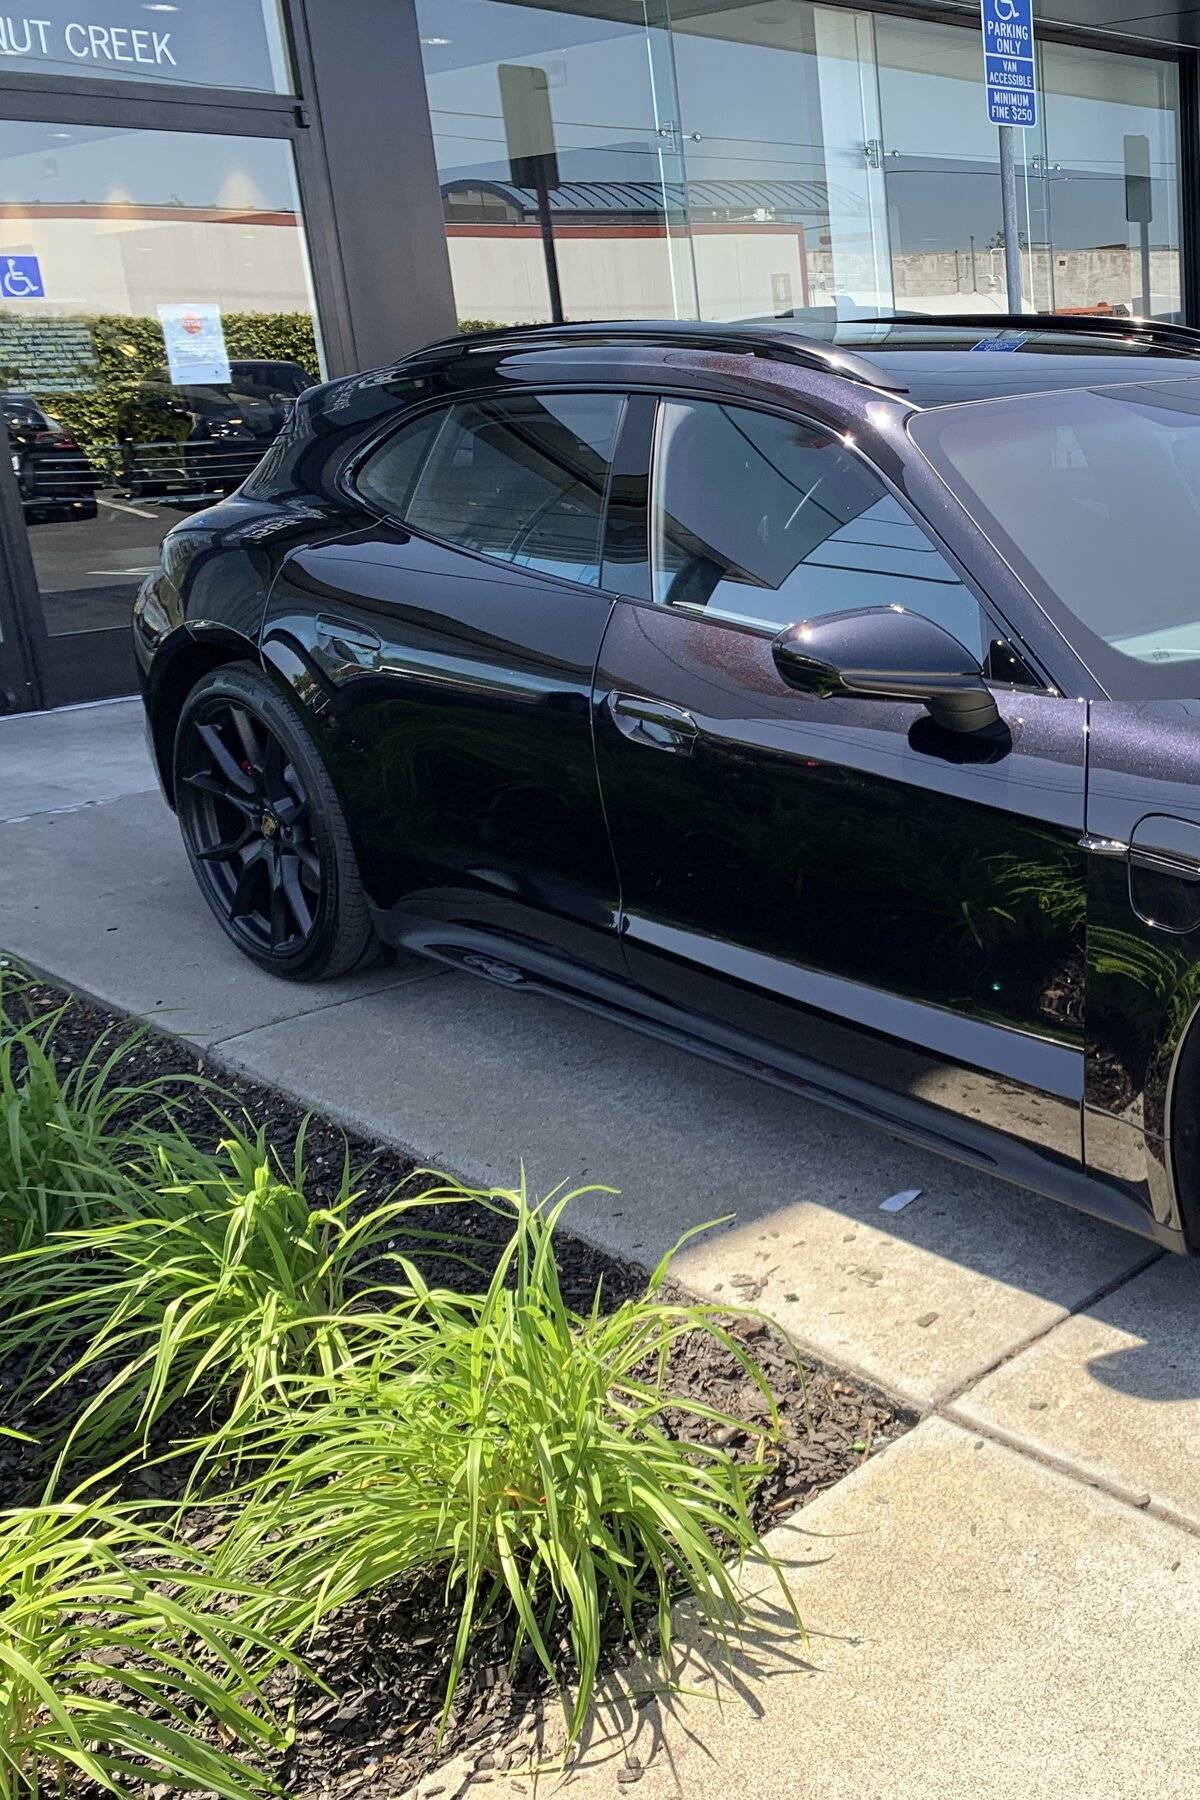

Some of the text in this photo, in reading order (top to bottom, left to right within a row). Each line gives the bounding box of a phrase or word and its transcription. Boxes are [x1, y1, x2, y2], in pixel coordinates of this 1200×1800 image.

[987, 20, 1029, 40] PARKING
[64, 22, 177, 66] CREEK
[996, 38, 1021, 55] ONLY
[1002, 60, 1017, 72] VAN
[989, 72, 1032, 87] ACCESSIBLE
[993, 92, 1029, 107] MINIMUM
[991, 106, 1032, 120] FINE $250
